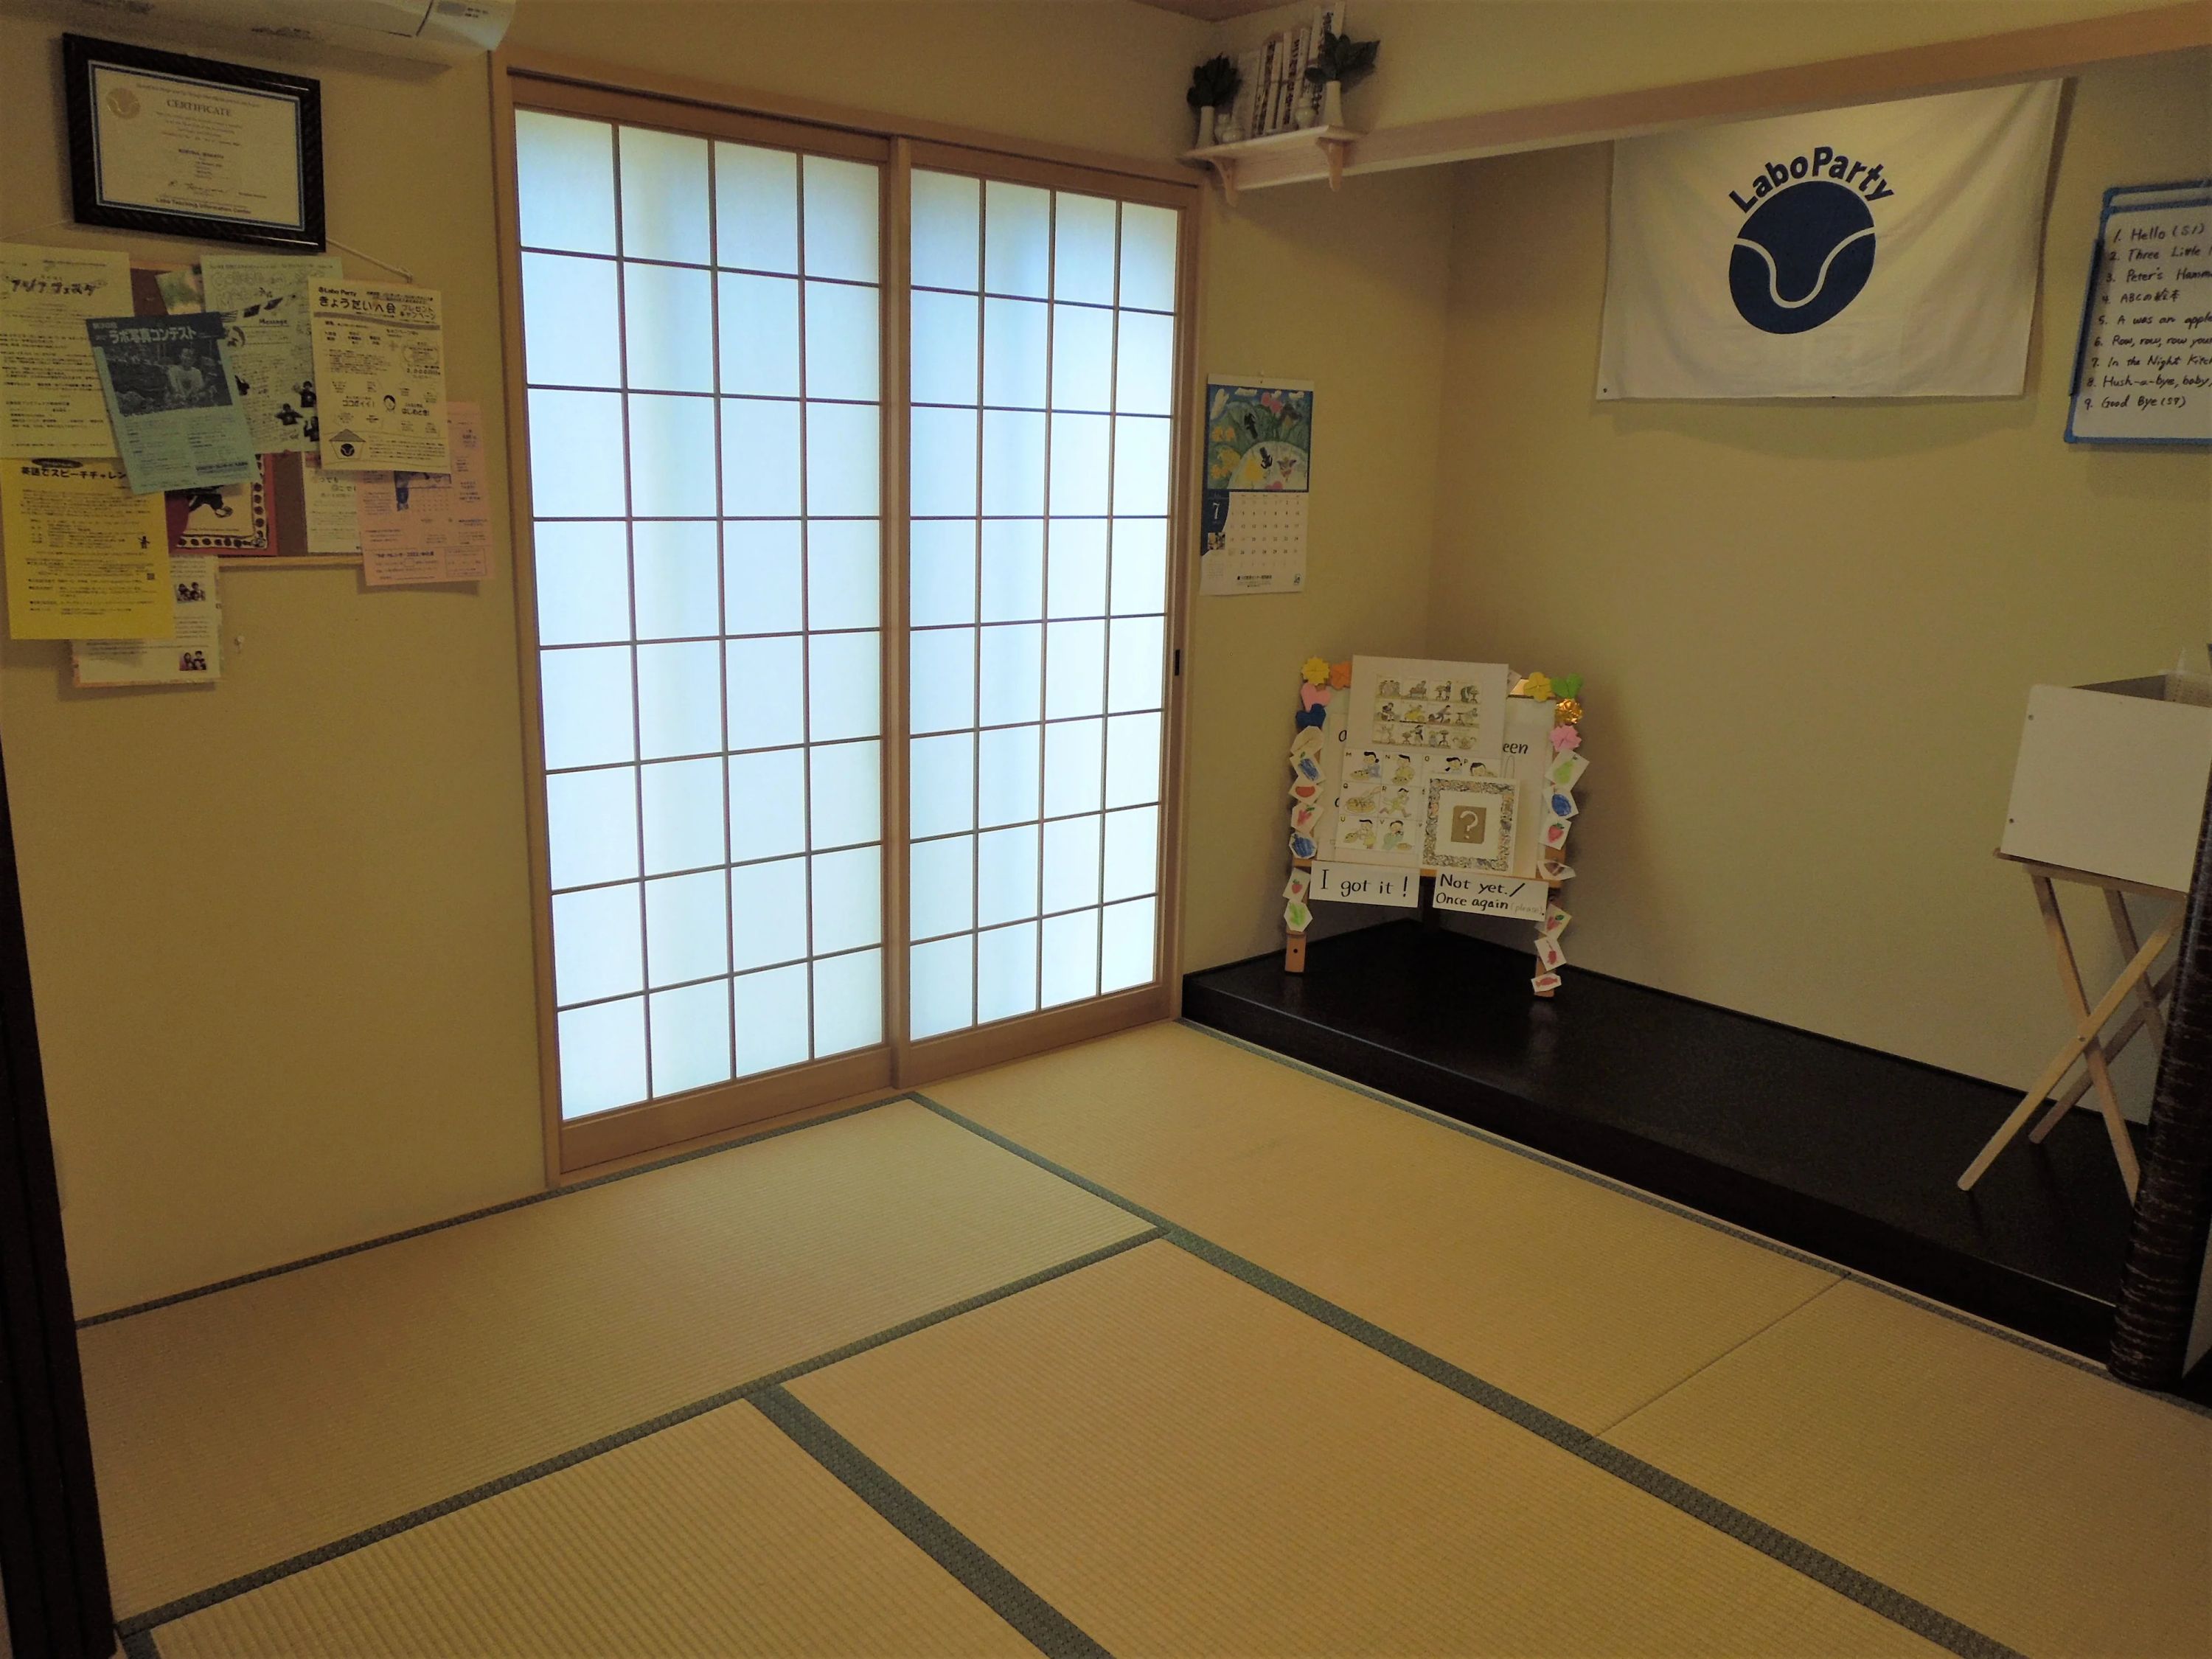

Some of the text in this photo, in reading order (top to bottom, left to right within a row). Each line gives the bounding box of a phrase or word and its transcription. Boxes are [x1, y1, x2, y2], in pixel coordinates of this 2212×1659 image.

[167, 99, 232, 116] CERTIFICATE
[2131, 227, 2166, 240] Hello
[2128, 248, 2160, 261] Three
[2171, 246, 2201, 257] Little
[2126, 267, 2164, 282] Peter's
[2118, 316, 2126, 325] A
[2133, 316, 2154, 325] was
[2166, 337, 2187, 345] row
[2108, 358, 2118, 367] In
[2127, 358, 2141, 366] the
[2147, 355, 2182, 371] Night
[2101, 396, 2130, 408] Good
[1212, 502, 1220, 520] 7
[1320, 869, 1329, 891] I
[1340, 879, 1368, 899] got
[1380, 881, 1392, 895] it
[1439, 874, 1472, 889] Not
[1436, 893, 1467, 907] Once
[1471, 897, 1509, 911] again
